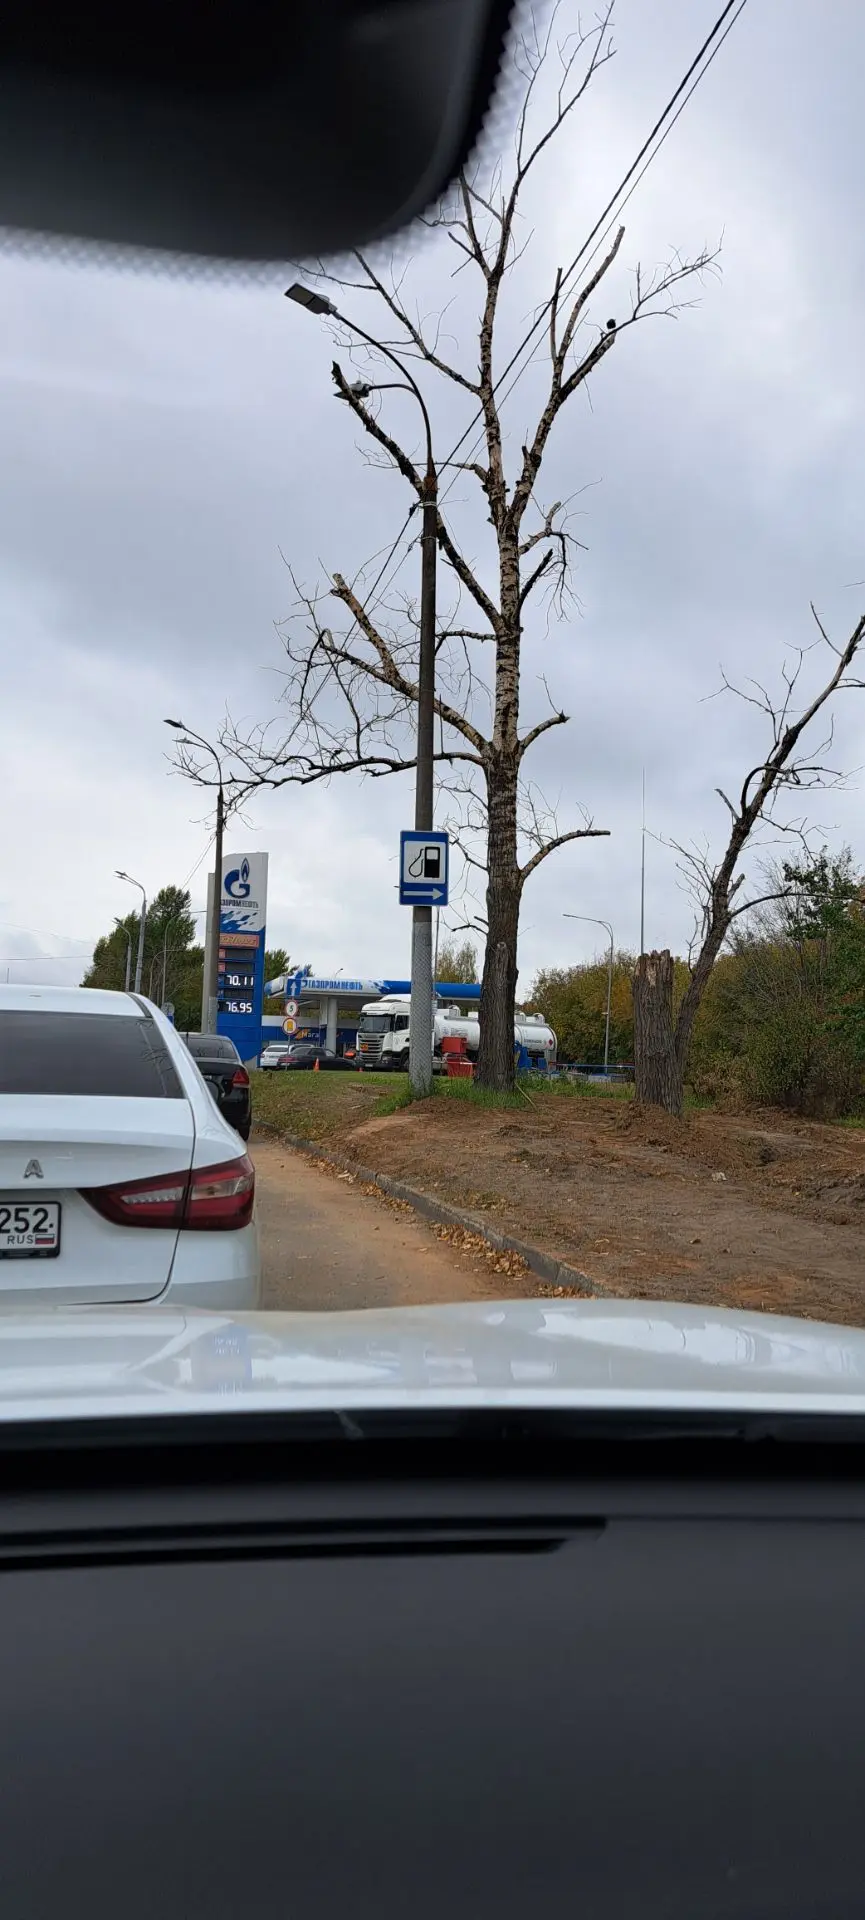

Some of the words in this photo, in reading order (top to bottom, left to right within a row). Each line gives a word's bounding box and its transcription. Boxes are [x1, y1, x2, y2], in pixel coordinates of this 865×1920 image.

[221, 899, 259, 908] ЗПРОМНЕФТЬ
[227, 975, 254, 986] 70.11
[308, 979, 363, 991] ГАЗПРОМНЕФТЬ
[226, 1001, 253, 1013] 76.95
[7, 1234, 34, 1245] RUS
